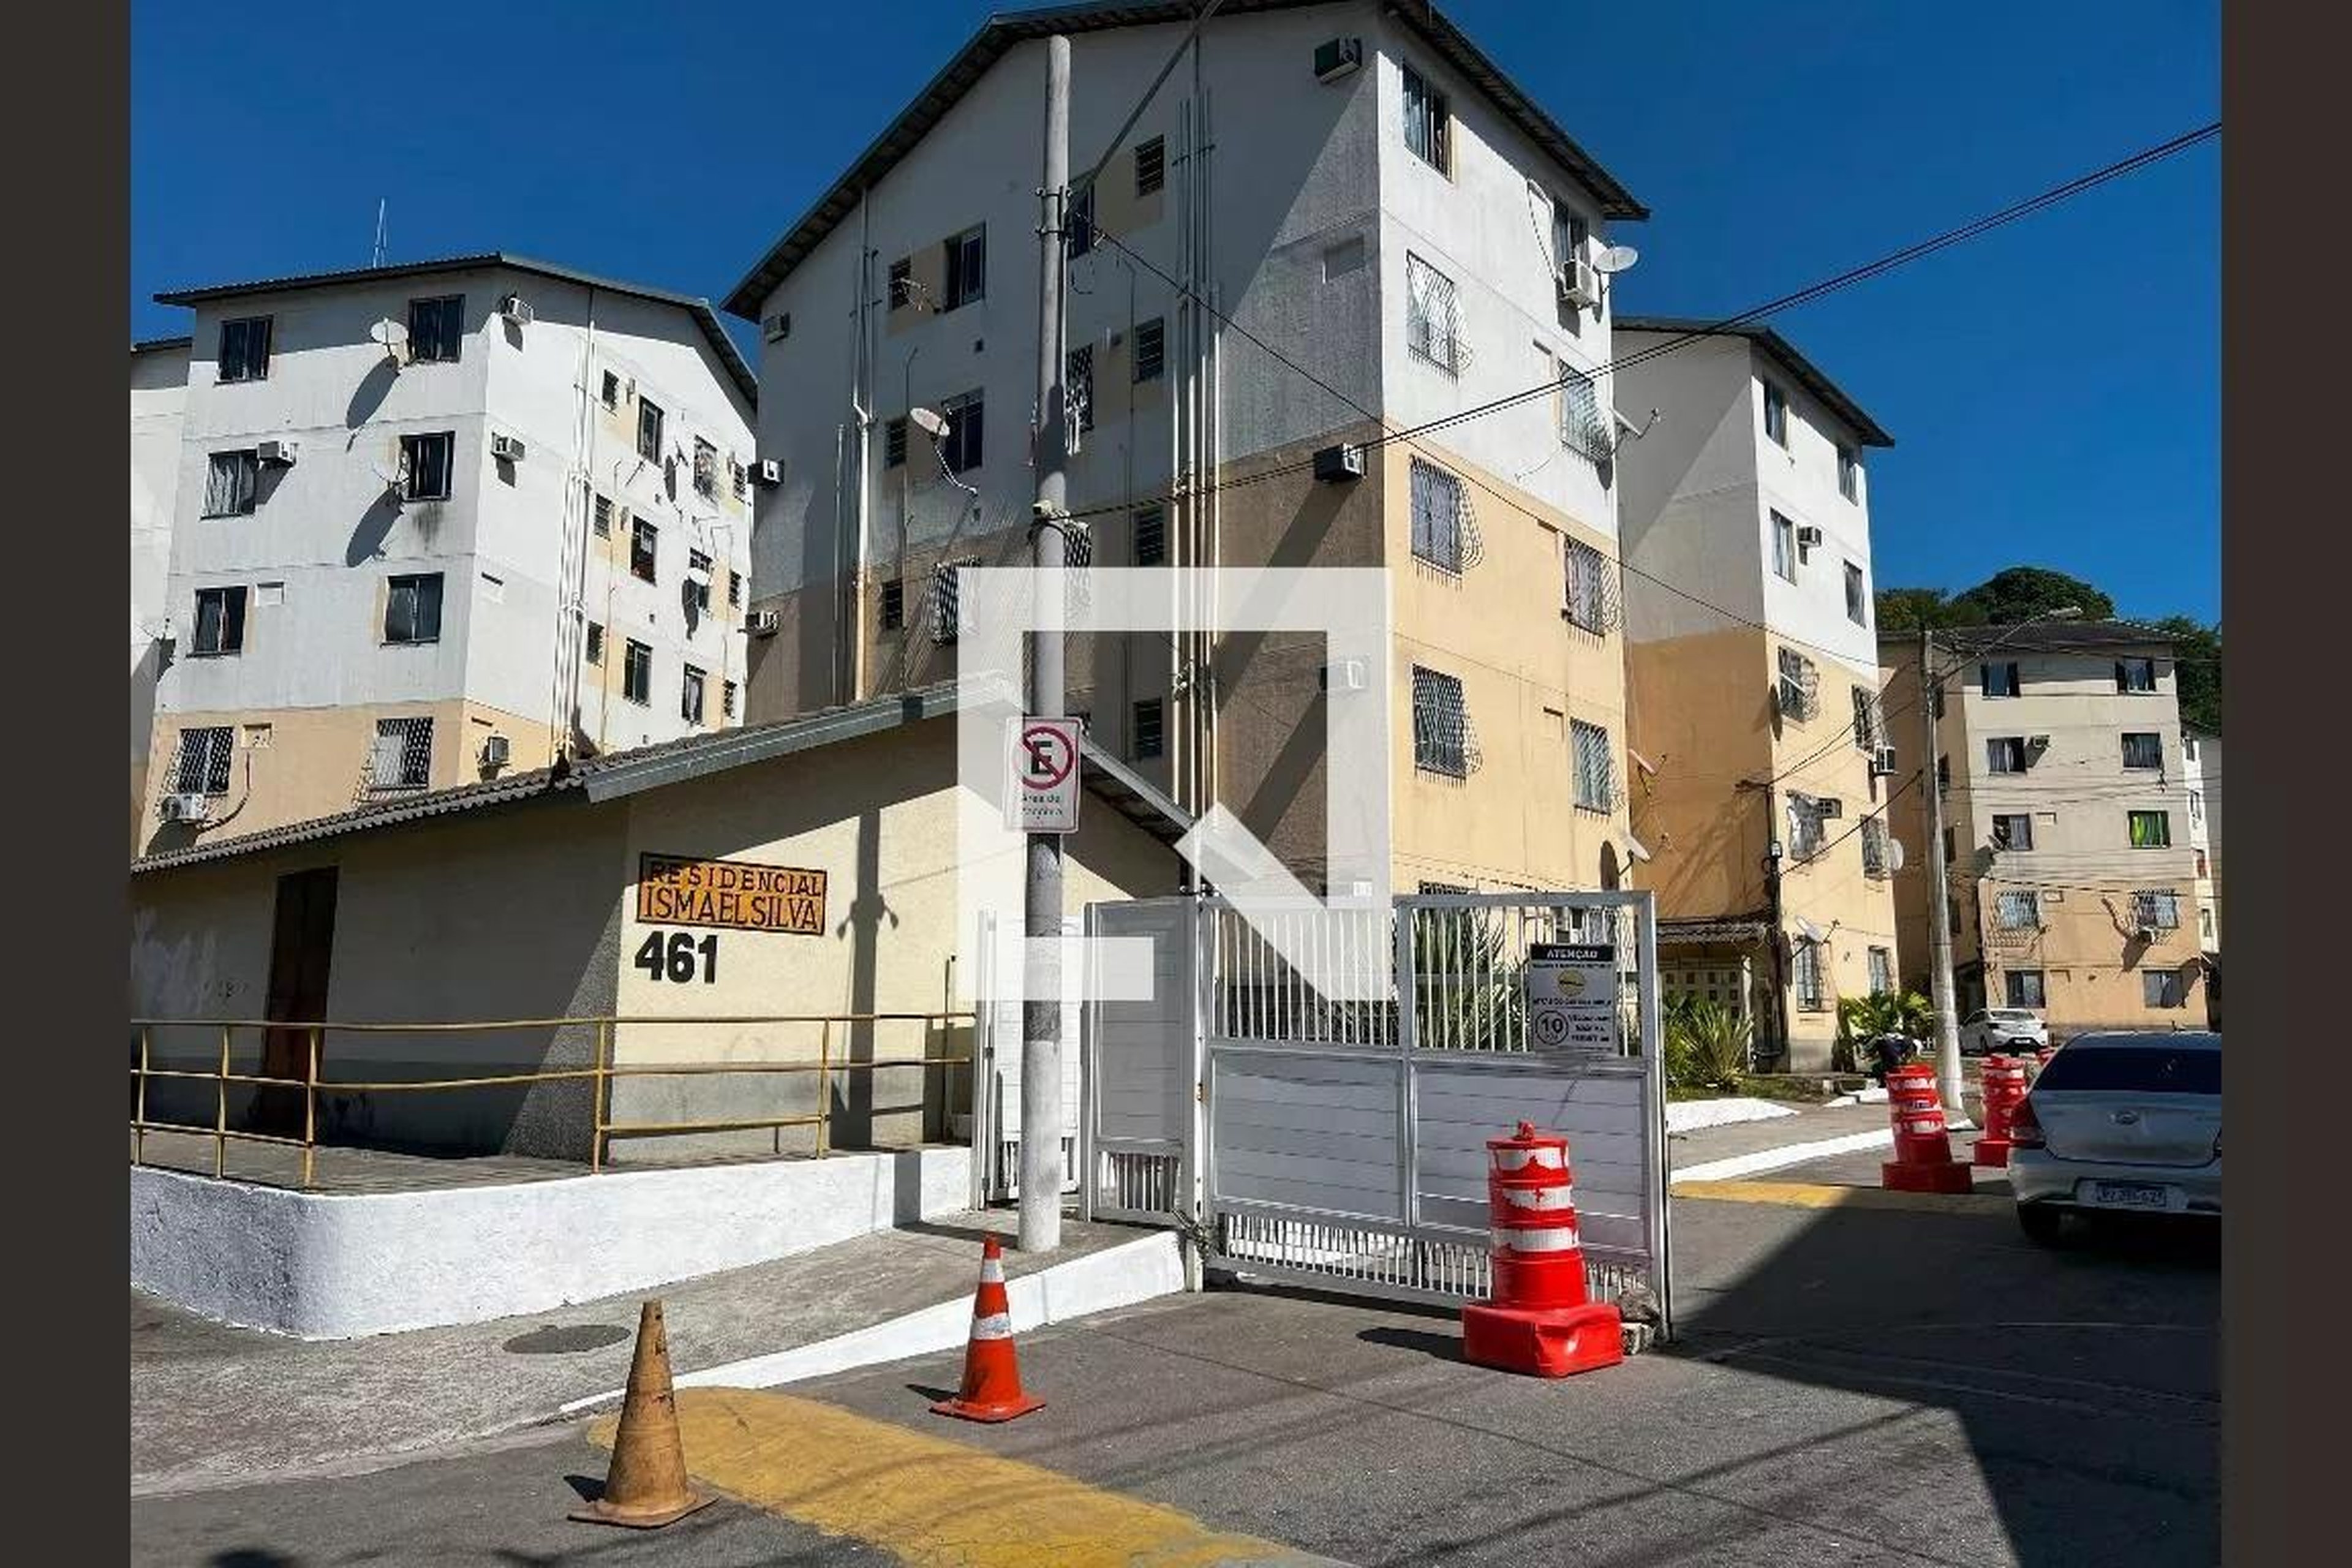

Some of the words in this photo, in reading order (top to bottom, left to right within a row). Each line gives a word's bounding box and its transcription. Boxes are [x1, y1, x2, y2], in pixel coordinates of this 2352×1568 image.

[650, 860, 821, 897] RESIDENCIAL
[643, 886, 747, 924] ISMAEL
[751, 895, 818, 929] SILVA
[635, 931, 718, 984] 461
[1542, 1017, 1563, 1033] 10
